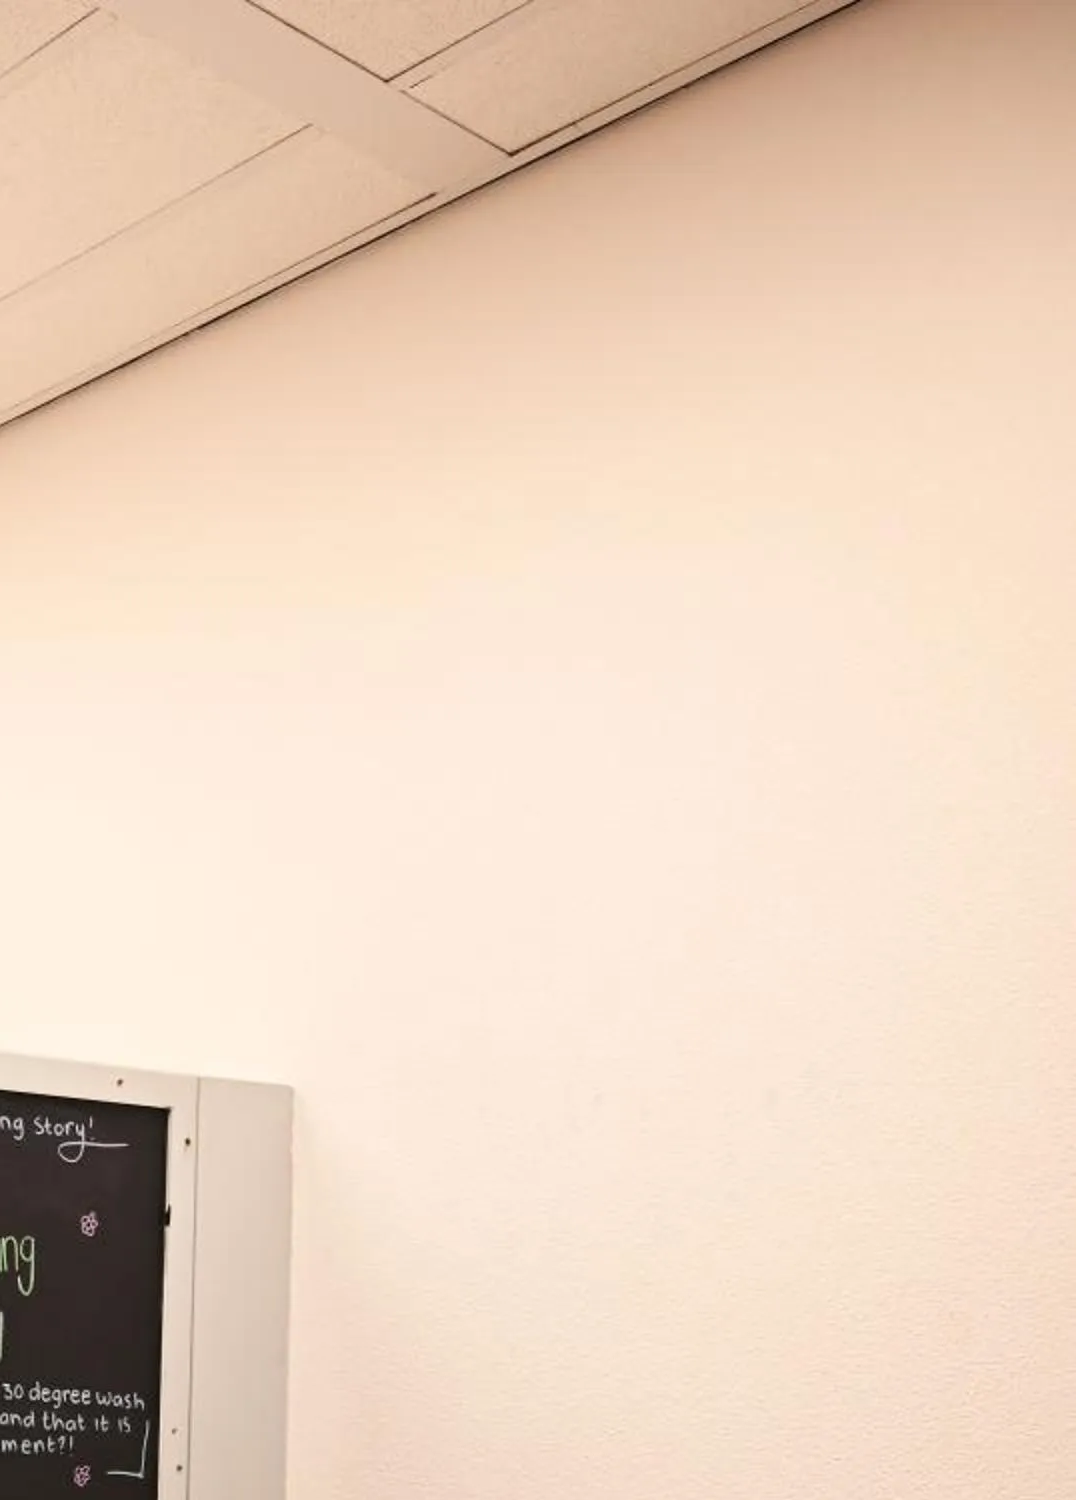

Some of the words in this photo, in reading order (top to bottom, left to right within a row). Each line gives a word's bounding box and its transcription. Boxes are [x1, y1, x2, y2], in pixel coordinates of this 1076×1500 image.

[2, 1382, 25, 1401] 30
[28, 1381, 92, 1410] degree
[95, 1391, 145, 1413] wash
[0, 1411, 36, 1429] and
[42, 1411, 86, 1433] that
[94, 1415, 110, 1433] it
[117, 1415, 132, 1433] is
